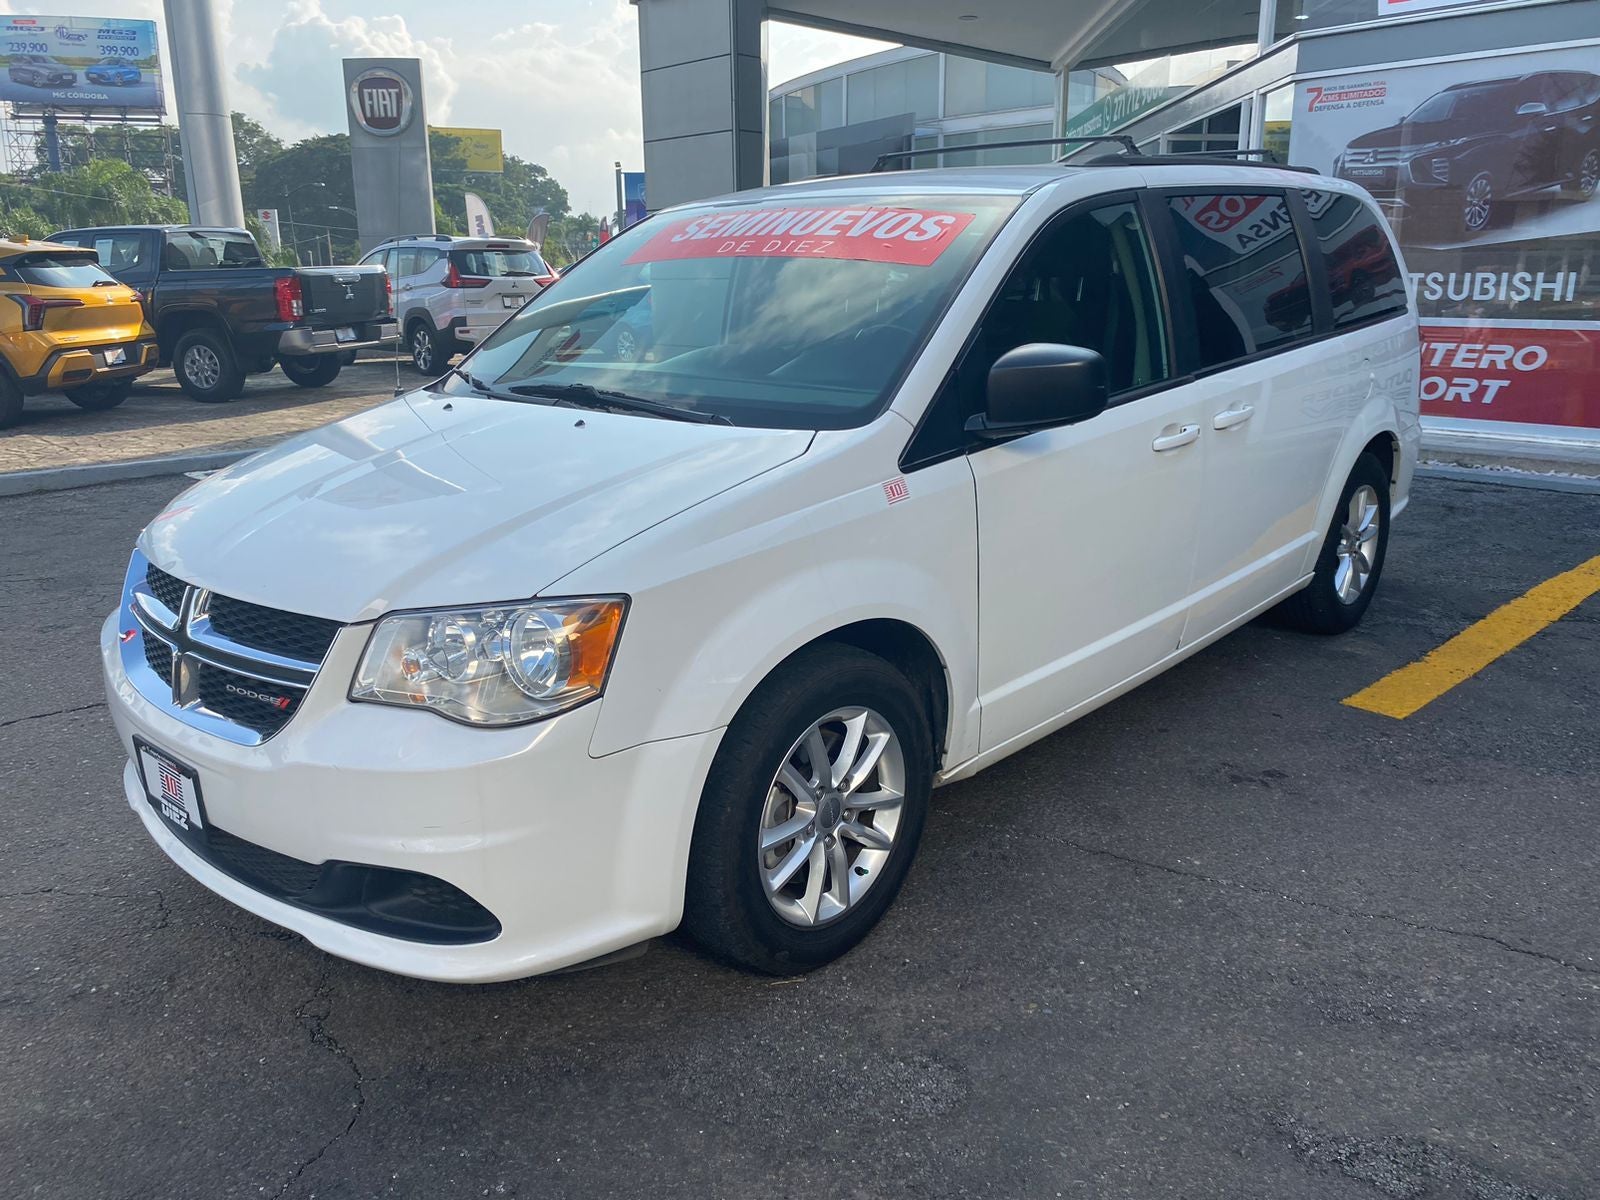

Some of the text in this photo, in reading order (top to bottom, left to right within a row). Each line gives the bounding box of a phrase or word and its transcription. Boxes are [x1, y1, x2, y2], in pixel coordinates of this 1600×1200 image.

[363, 88, 399, 118] FIAT
[1306, 87, 1323, 112] 7
[1314, 103, 1345, 112] DEFENSA
[1353, 99, 1385, 108] DEFENSA
[1321, 93, 1340, 102] KMS
[671, 209, 957, 242] SEMINUEVOS
[717, 240, 835, 254] DE DIEZ
[1421, 343, 1548, 372] TERO
[226, 684, 281, 706] DODGE
[161, 799, 189, 831] DIEZ
